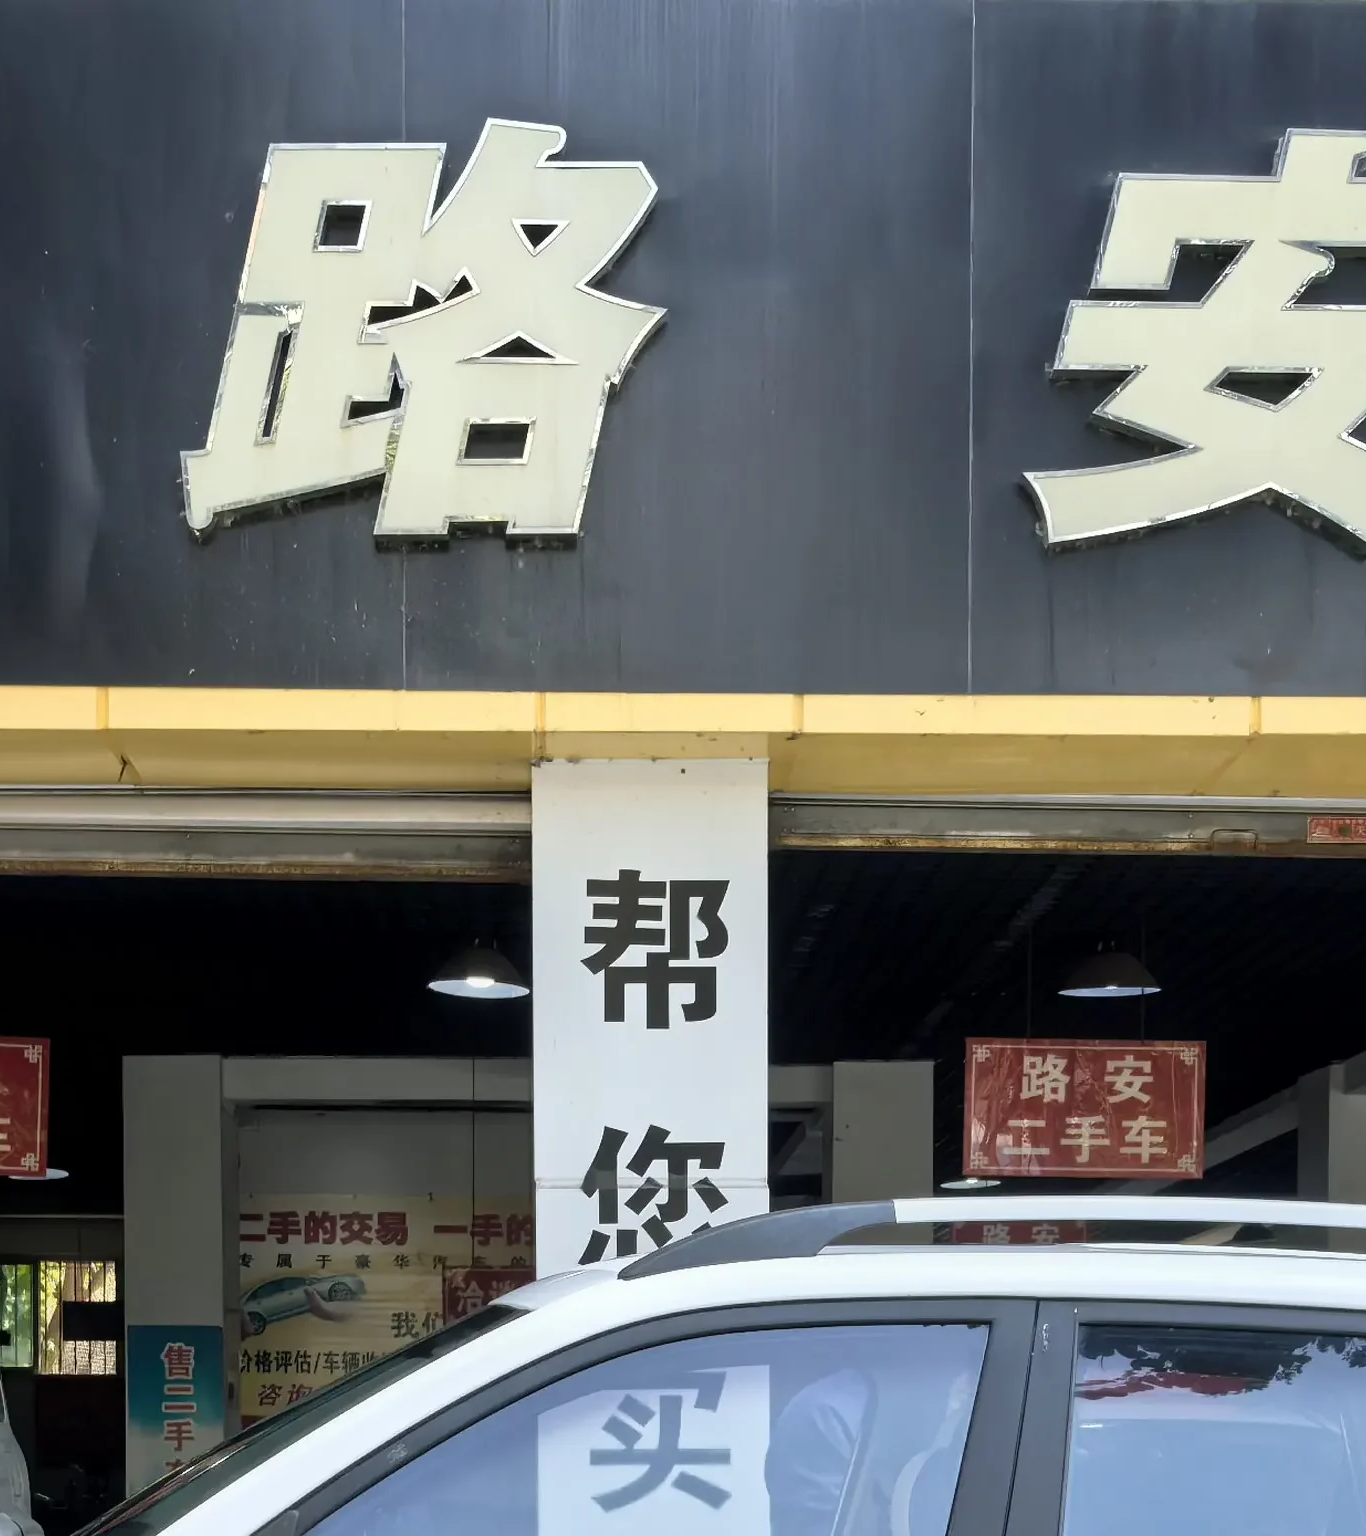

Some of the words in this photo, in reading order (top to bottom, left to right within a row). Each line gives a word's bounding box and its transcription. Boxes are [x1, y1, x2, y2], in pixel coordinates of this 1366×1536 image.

[1020, 1054, 1155, 1105] 路安
[1002, 1115, 1169, 1164] 二手车
[239, 1210, 409, 1246] 二手的交易
[982, 1223, 1060, 1245] 路安
[239, 1349, 392, 1376] 价格评估/车辆收
